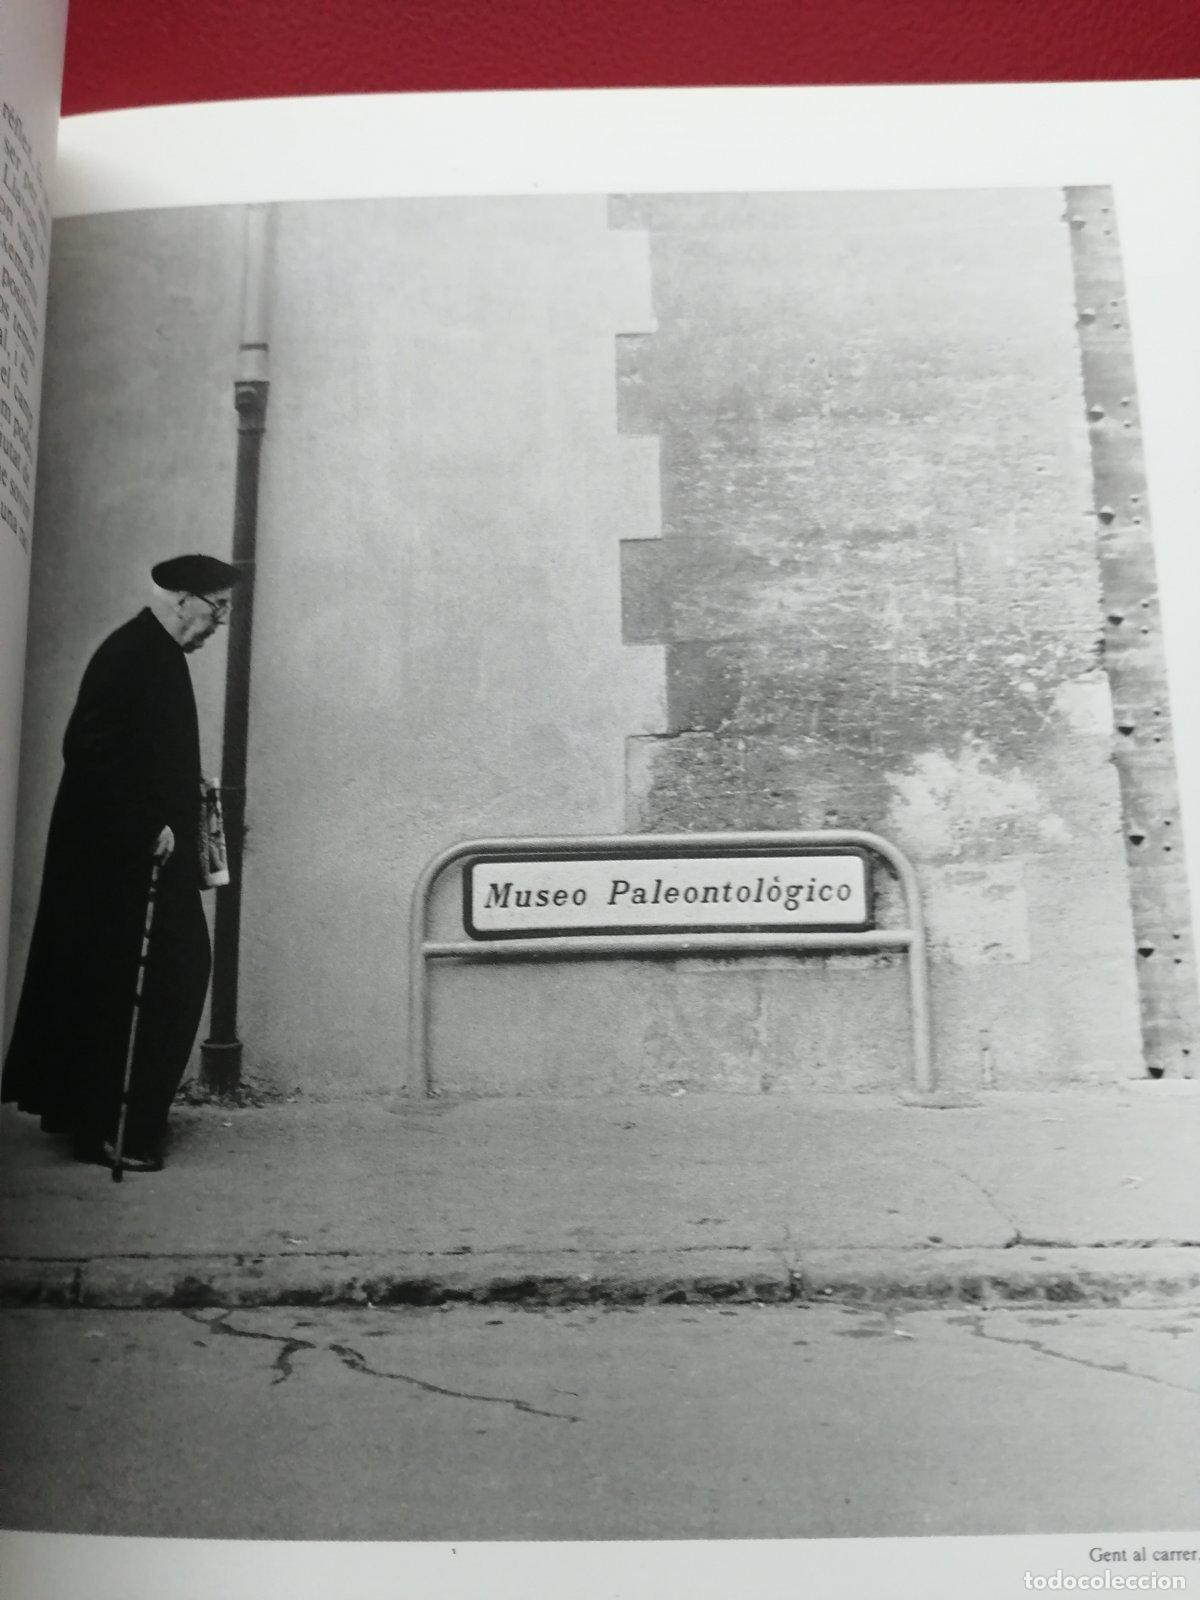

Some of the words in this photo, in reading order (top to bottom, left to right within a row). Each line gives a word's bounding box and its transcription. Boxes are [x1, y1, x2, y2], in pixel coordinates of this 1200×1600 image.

[484, 882, 588, 909] Museo
[607, 875, 853, 912] Paleontológico
[1089, 1547, 1127, 1562] Gent
[1133, 1546, 1146, 1562] al
